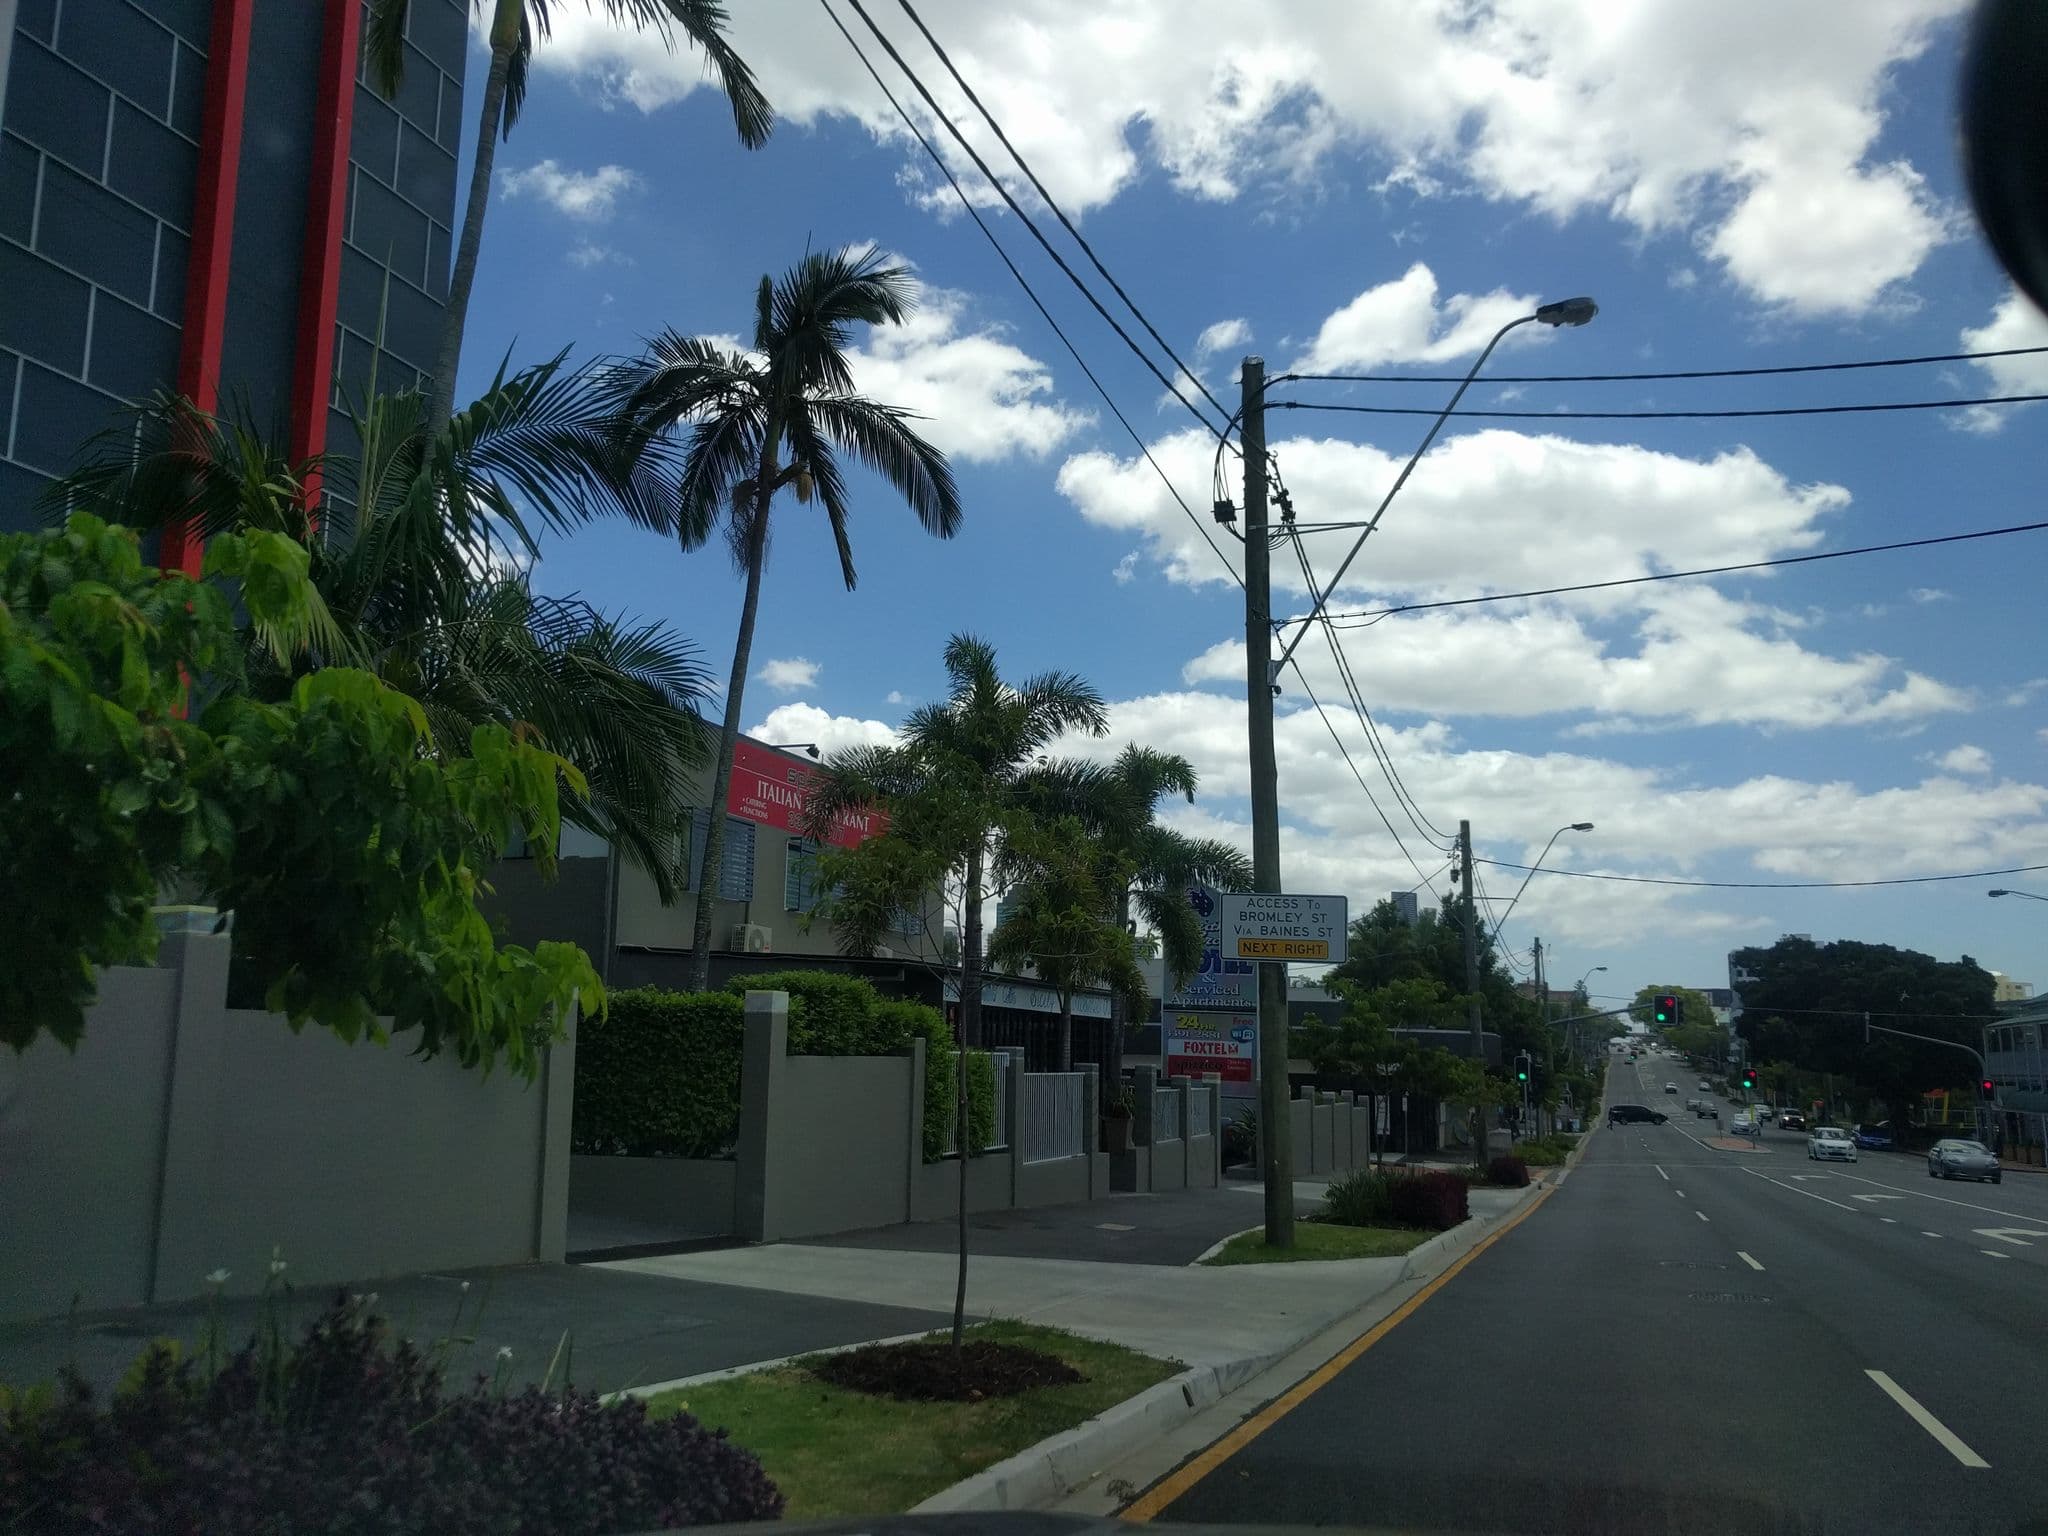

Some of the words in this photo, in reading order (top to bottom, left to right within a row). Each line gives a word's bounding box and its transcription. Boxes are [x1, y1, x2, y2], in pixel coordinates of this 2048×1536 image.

[757, 779, 802, 809] ITALIAN
[1246, 898, 1299, 909] ACCESS
[1239, 911, 1303, 923] BROMLEY
[1311, 912, 1328, 924] ST
[1260, 925, 1310, 937] BAINES
[1317, 926, 1334, 938] ST
[1242, 941, 1278, 954] NEXT
[1284, 943, 1324, 955] RIGHT
[1182, 983, 1240, 996] Serviced
[1170, 992, 1252, 1008] Apartments
[1175, 1014, 1200, 1030] 24
[1183, 1040, 1228, 1055] FOXTEL
